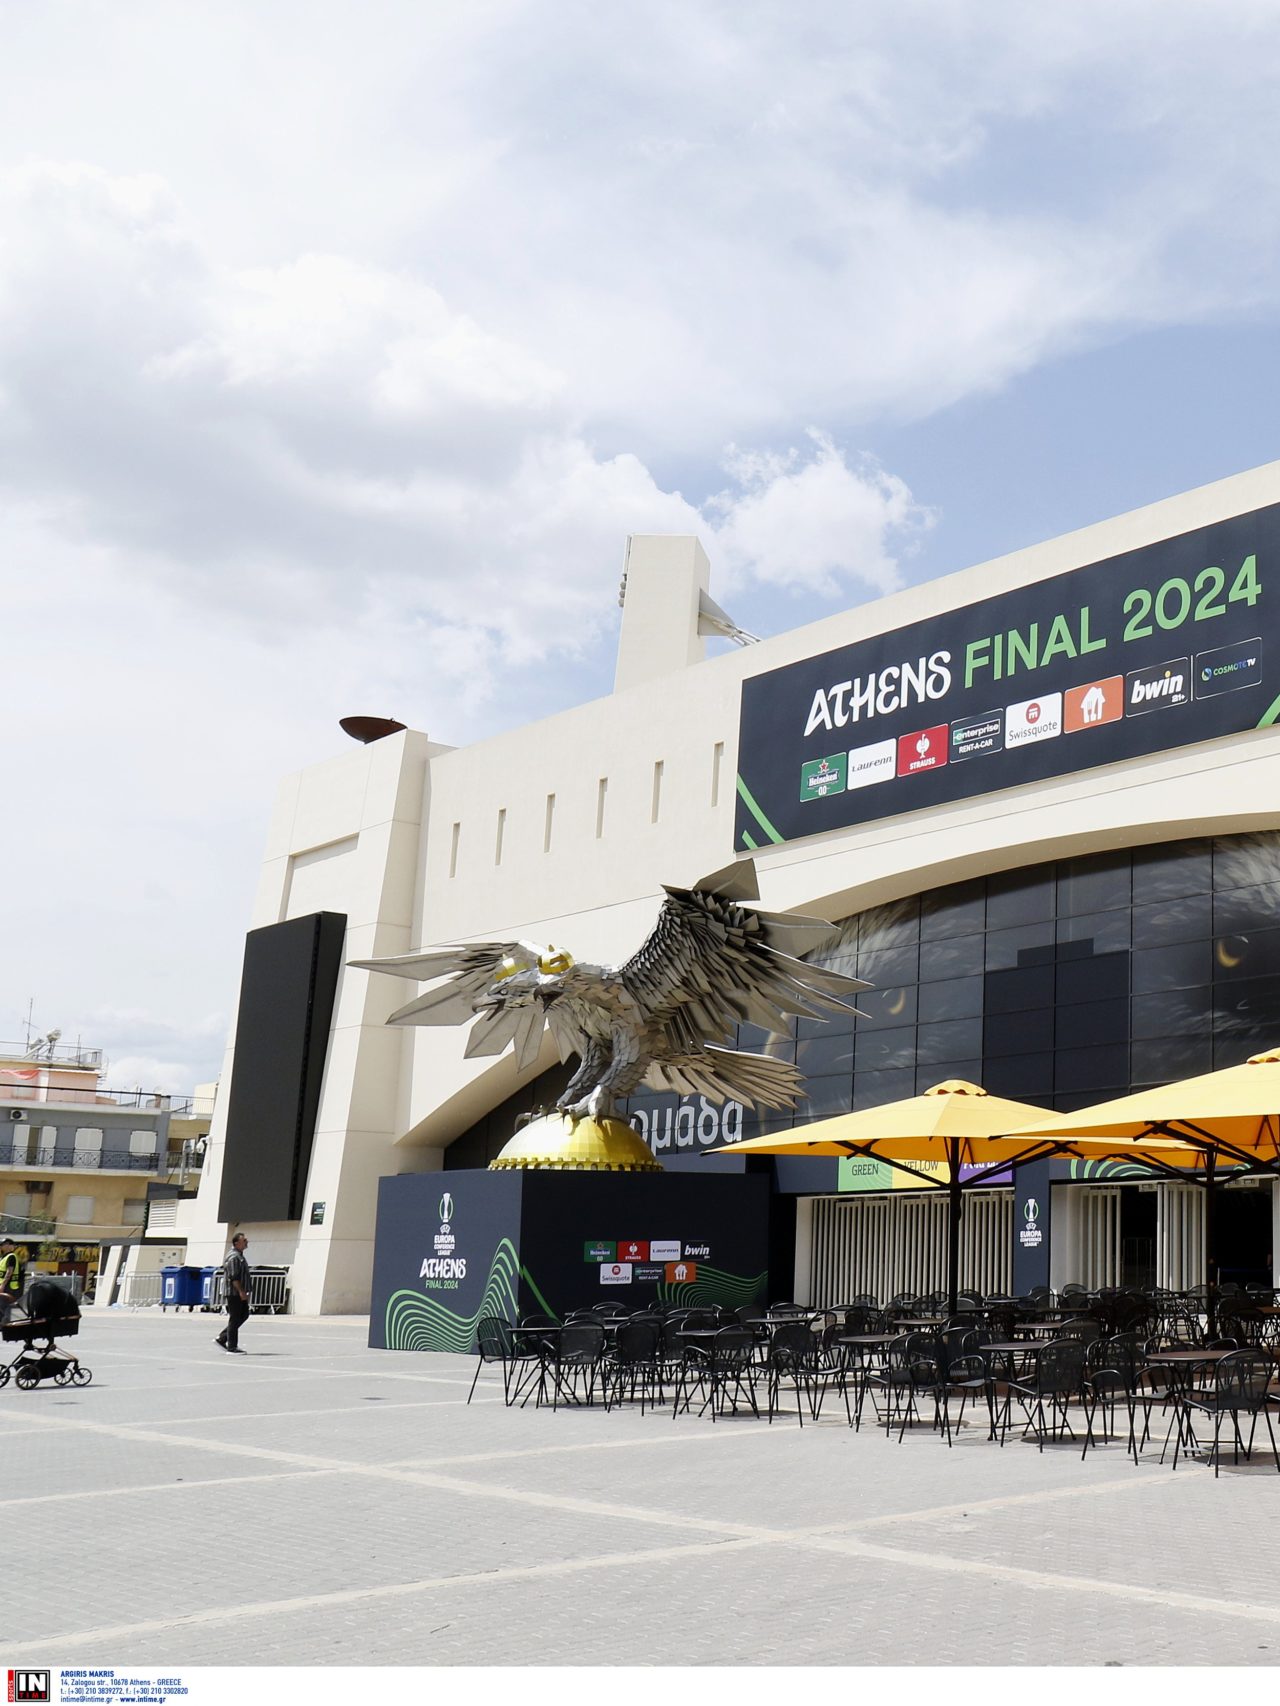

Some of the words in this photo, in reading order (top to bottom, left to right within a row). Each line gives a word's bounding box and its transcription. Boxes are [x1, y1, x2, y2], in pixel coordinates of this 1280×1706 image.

[803, 650, 952, 737] ATHENS
[965, 606, 1107, 689] FINAL
[1122, 554, 1262, 642] 2024
[1131, 671, 1184, 704] bwin
[955, 723, 999, 740] enterprise
[1008, 719, 1058, 742] Swissquote
[958, 738, 993, 754] RENT-A-CAR
[909, 757, 936, 770] STRAUSS
[808, 771, 838, 787] Heineken
[852, 1163, 879, 1176] GREEN
[434, 1235, 455, 1244] EUROPA
[1020, 1230, 1042, 1238] EUROPA
[684, 1244, 710, 1256] bwin
[419, 1258, 467, 1279] ATHENS
[425, 1280, 442, 1289] FINAL
[444, 1280, 458, 1289] 2024
